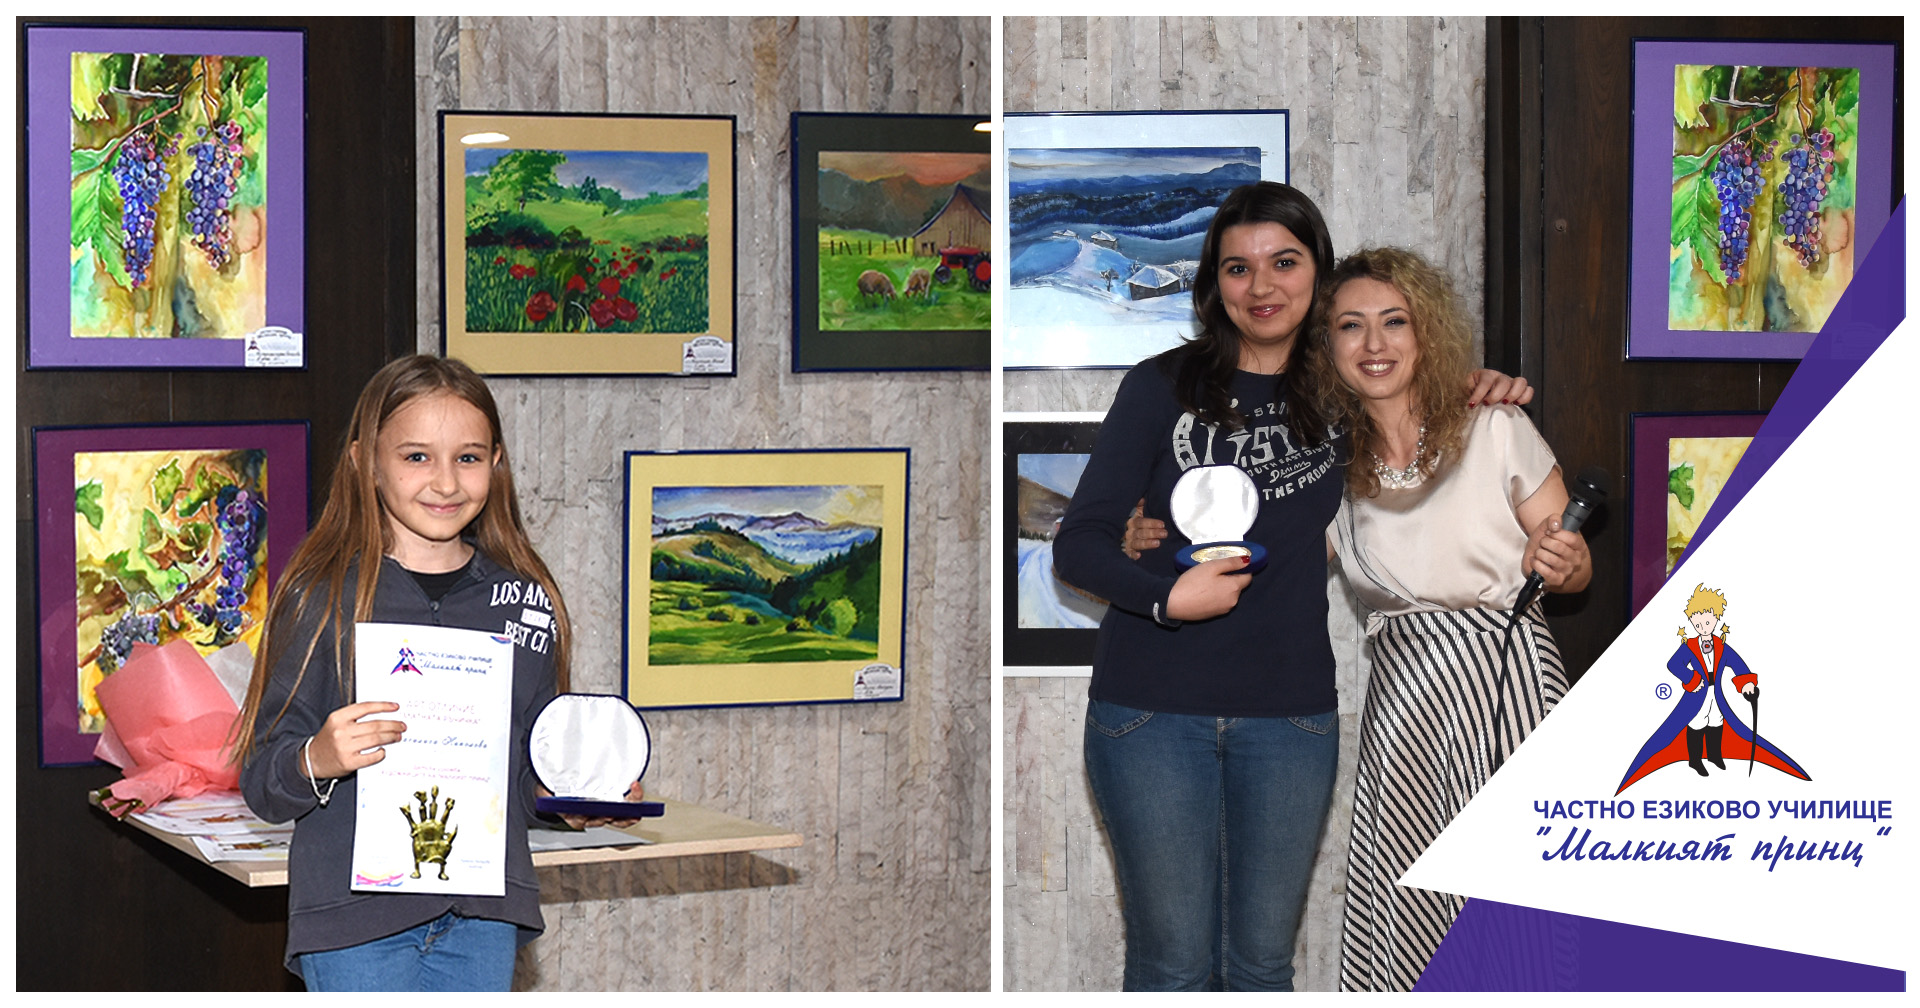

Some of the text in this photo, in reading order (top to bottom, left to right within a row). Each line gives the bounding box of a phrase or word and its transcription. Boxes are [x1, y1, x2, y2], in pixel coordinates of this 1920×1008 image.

[1246, 461, 1278, 478] OUTH
[1262, 482, 1295, 501] THE
[490, 580, 522, 607] LOS
[504, 620, 532, 648] BEST
